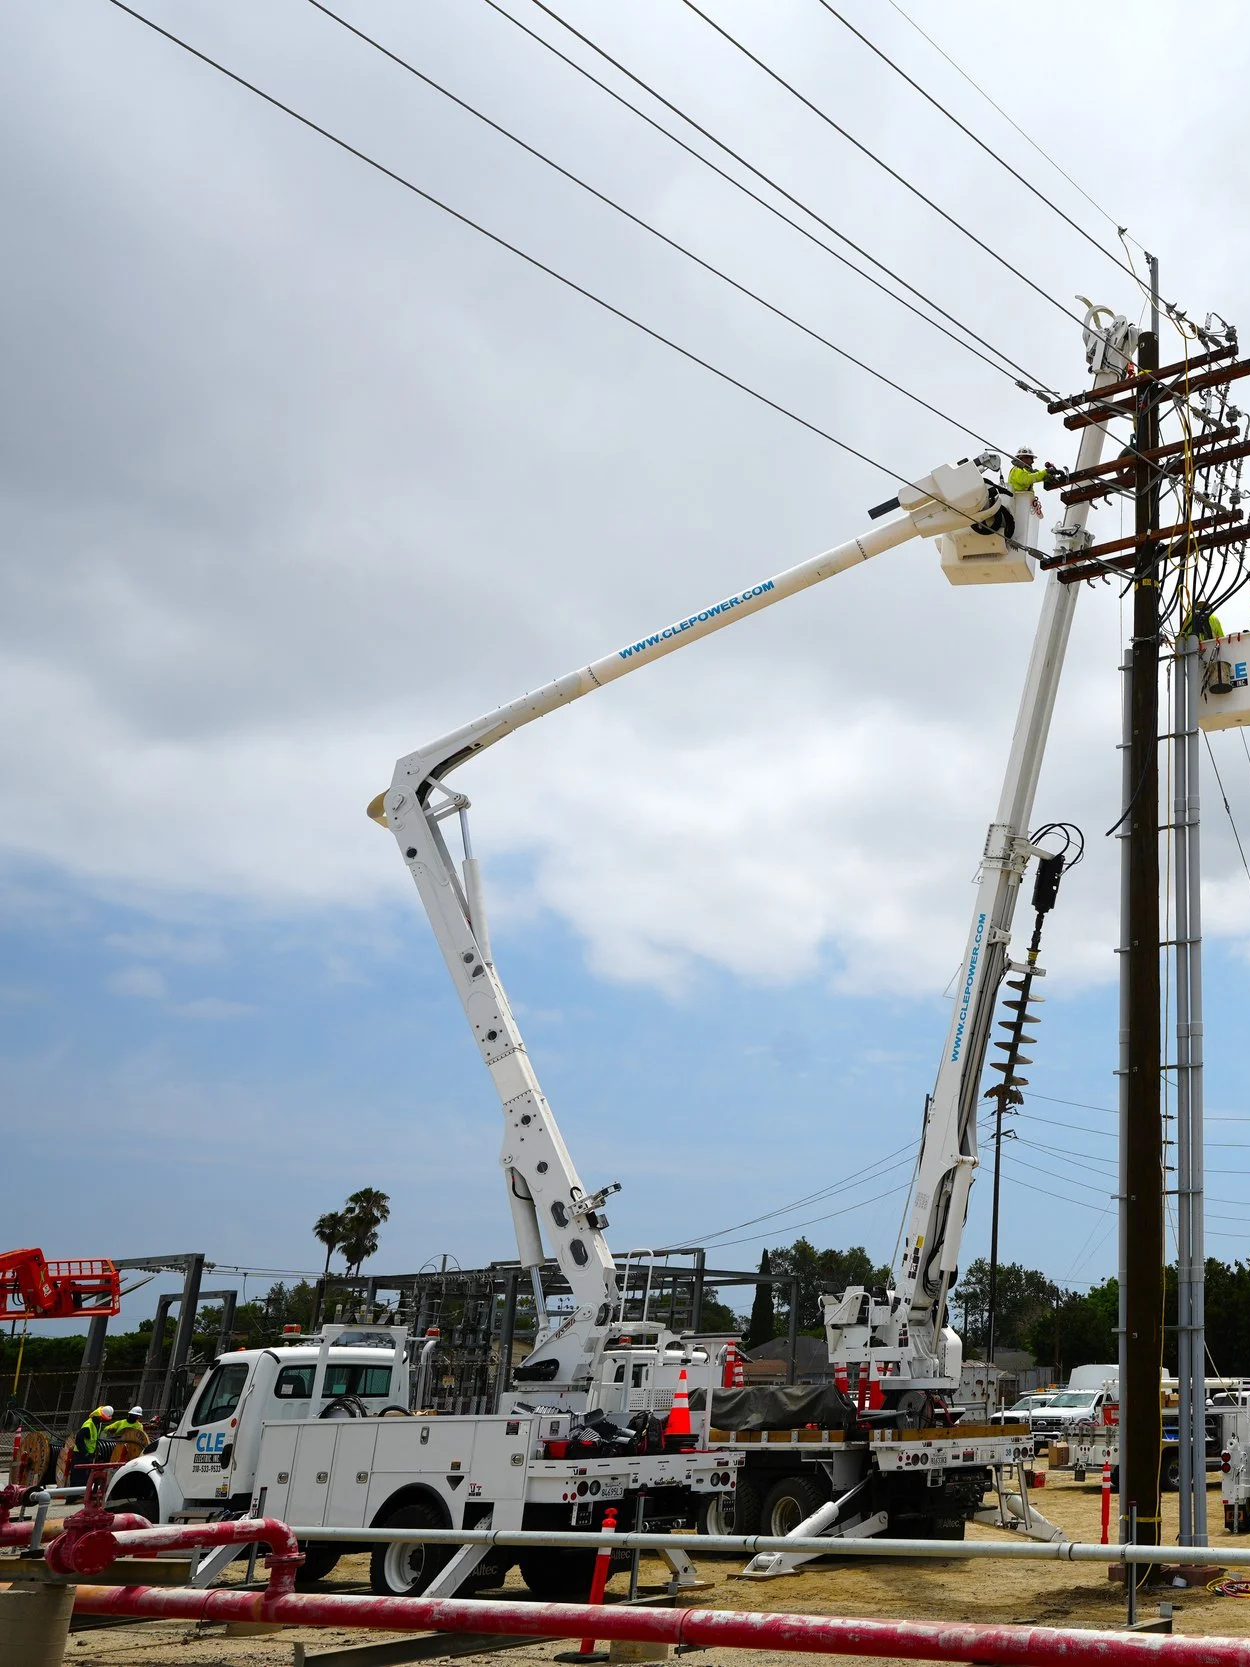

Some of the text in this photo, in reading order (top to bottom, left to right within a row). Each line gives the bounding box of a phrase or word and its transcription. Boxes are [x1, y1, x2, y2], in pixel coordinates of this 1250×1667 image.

[618, 580, 775, 660] WWW.CLEPOWER.COM
[951, 913, 986, 1062] WWW.CLEPOWER.COM
[196, 1433, 225, 1452] CLE
[472, 1564, 498, 1577] Altec
